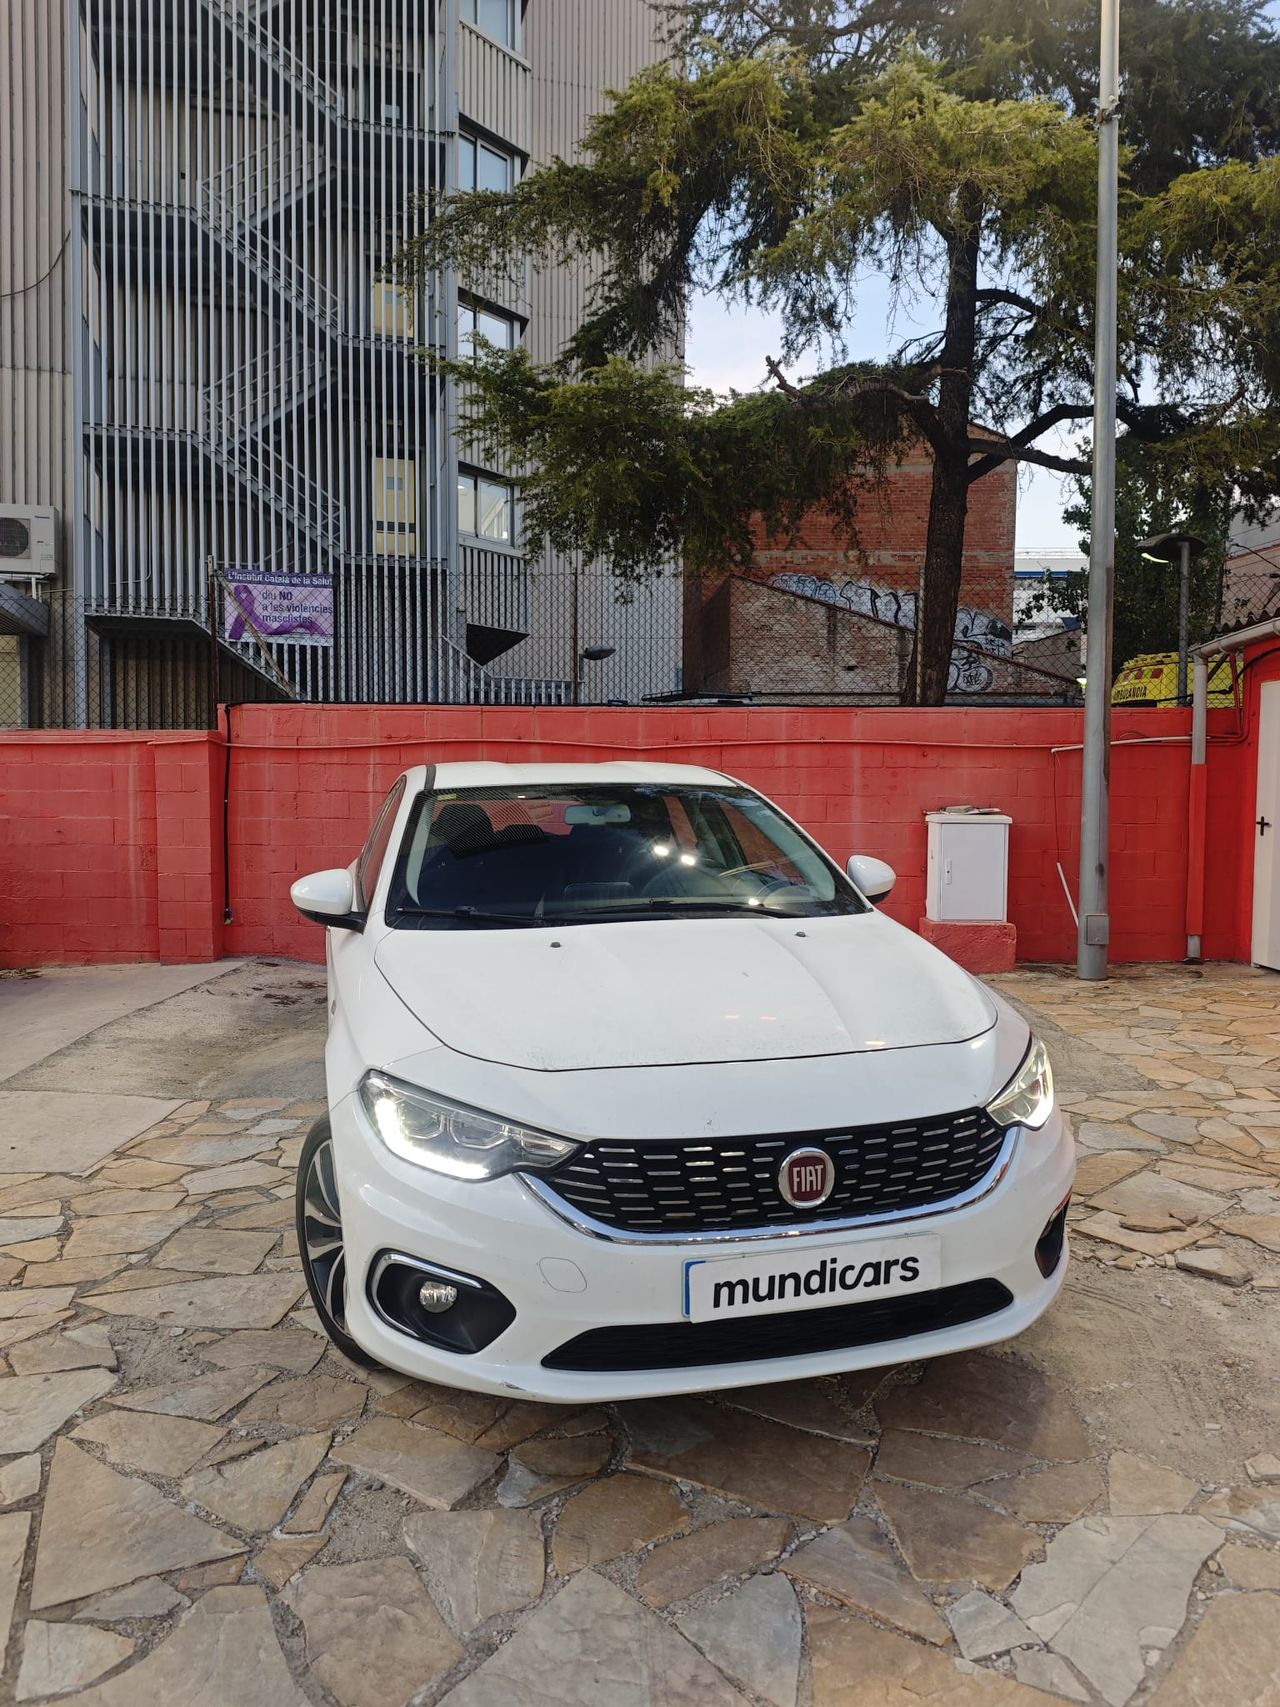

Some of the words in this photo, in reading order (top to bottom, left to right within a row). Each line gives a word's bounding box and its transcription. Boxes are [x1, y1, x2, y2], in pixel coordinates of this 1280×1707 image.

[228, 570, 262, 581] L'Institut
[291, 575, 302, 584] de
[303, 576, 311, 585] la
[262, 590, 277, 600] diu
[279, 591, 293, 601] NO
[270, 603, 286, 612] les
[262, 614, 313, 624] masclistes
[792, 1164, 824, 1193] FIAT
[713, 1255, 920, 1308] mundicars
